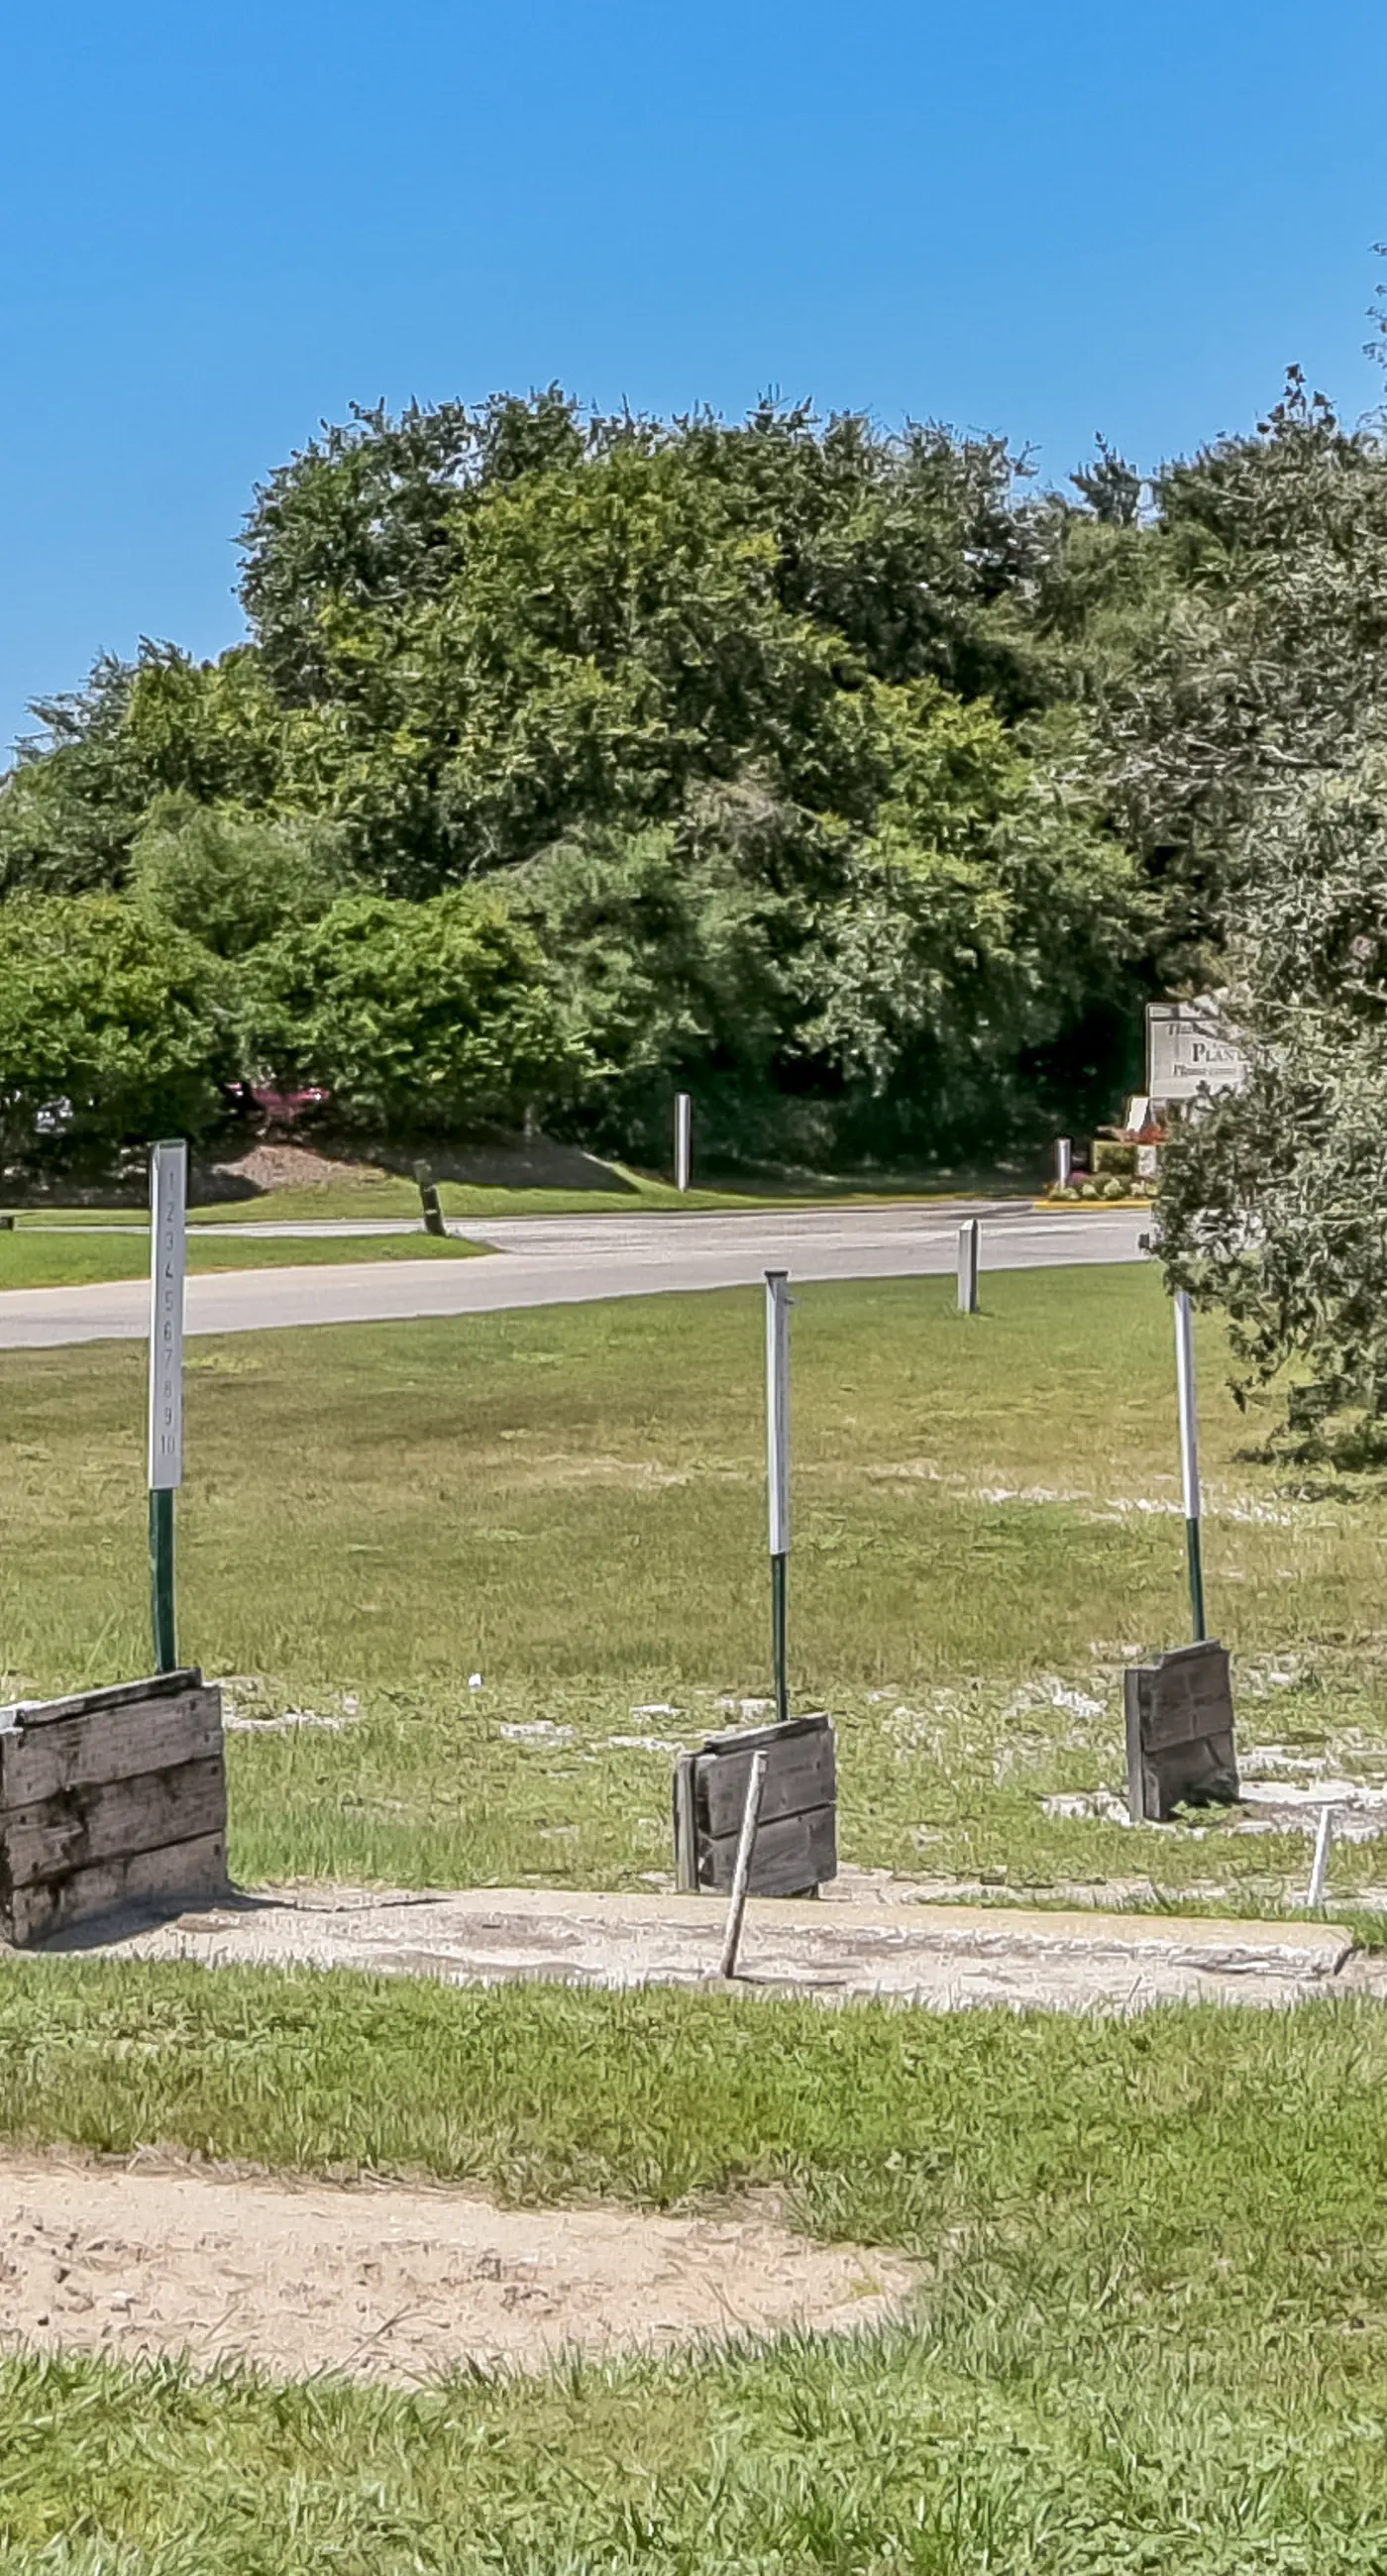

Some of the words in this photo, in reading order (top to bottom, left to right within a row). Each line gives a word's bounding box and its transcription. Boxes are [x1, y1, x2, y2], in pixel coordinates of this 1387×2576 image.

[166, 1201, 174, 1223] 2
[166, 1231, 173, 1252] 3
[165, 1259, 173, 1279] 4
[165, 1290, 173, 1312] 5
[163, 1320, 171, 1342] 6
[163, 1348, 172, 1368] 7
[163, 1379, 171, 1399] 8
[163, 1407, 171, 1427] 9
[160, 1434, 175, 1454] 10
